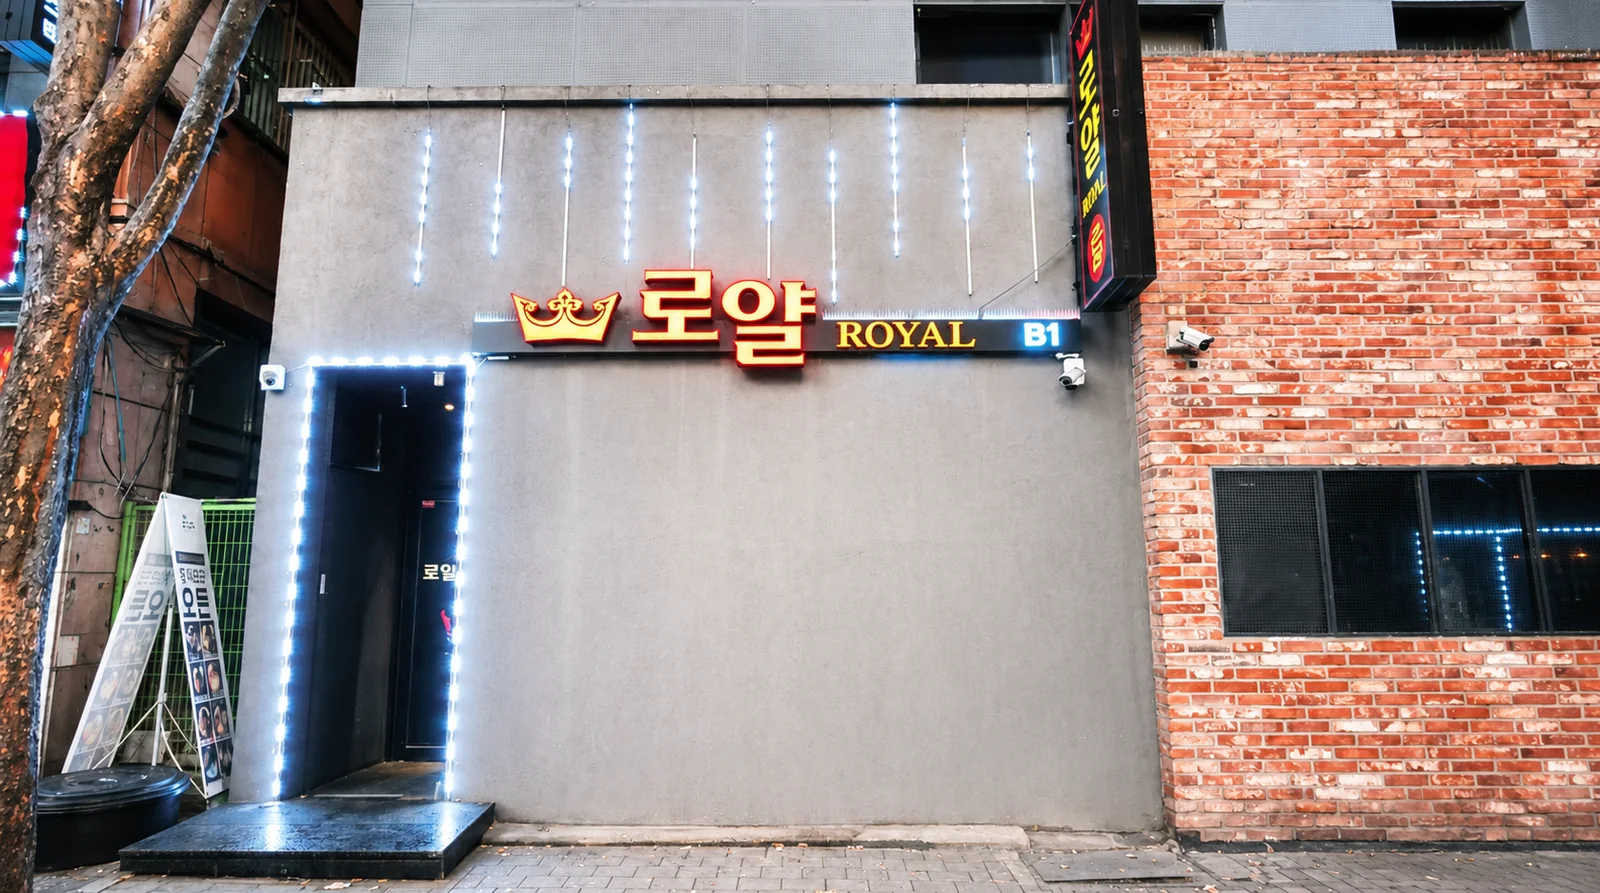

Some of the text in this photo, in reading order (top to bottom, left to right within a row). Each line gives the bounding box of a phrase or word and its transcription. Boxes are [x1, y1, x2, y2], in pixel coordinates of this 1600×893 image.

[1079, 48, 1100, 179] 로얄
[632, 269, 1060, 368] 로얄 ROYAL B1
